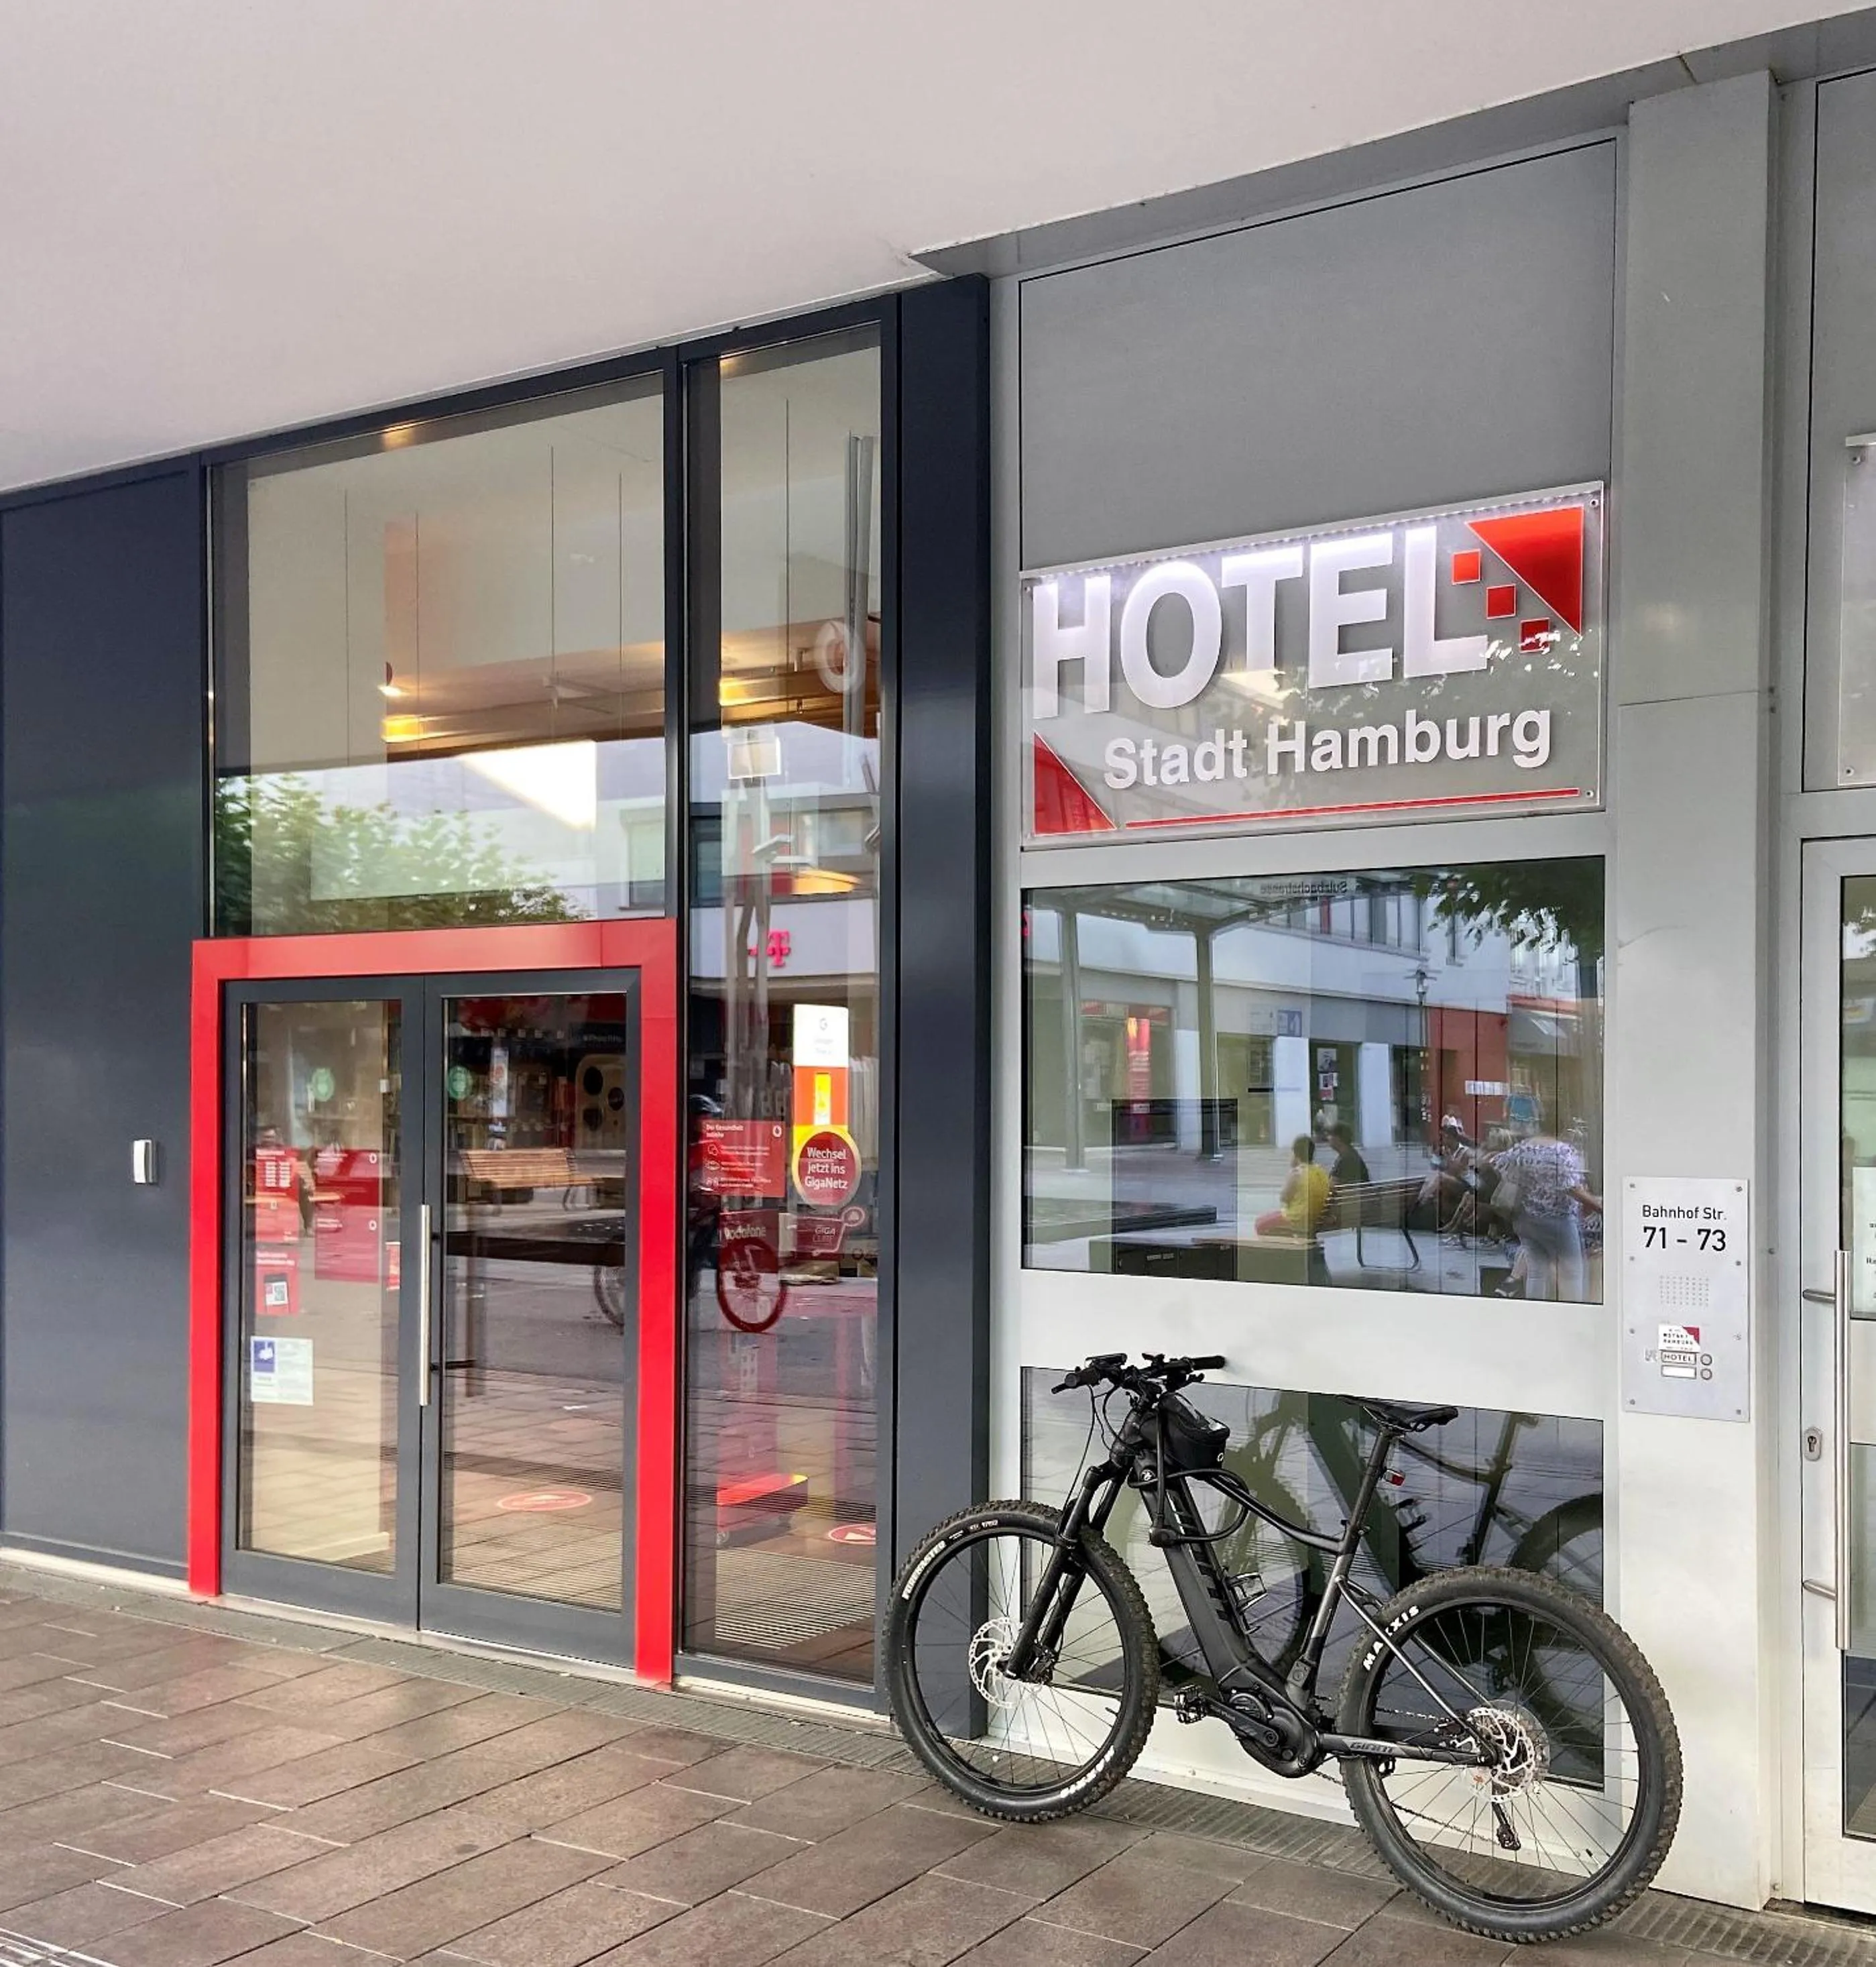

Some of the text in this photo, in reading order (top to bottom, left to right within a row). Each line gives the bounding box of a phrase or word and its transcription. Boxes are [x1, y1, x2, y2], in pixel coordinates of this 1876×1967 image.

[1033, 525, 1488, 718] HOTEL
[1103, 708, 1551, 789] Stadt Hamburg
[807, 1147, 846, 1160] Wechsel
[807, 1162, 845, 1174] jetzt ins
[805, 1176, 848, 1190] GigaNetz
[1642, 1204, 1727, 1220] Bahnhof Str.
[1643, 1226, 1666, 1249] 71
[1697, 1228, 1726, 1251] 73
[1664, 1354, 1694, 1363] HOTEL
